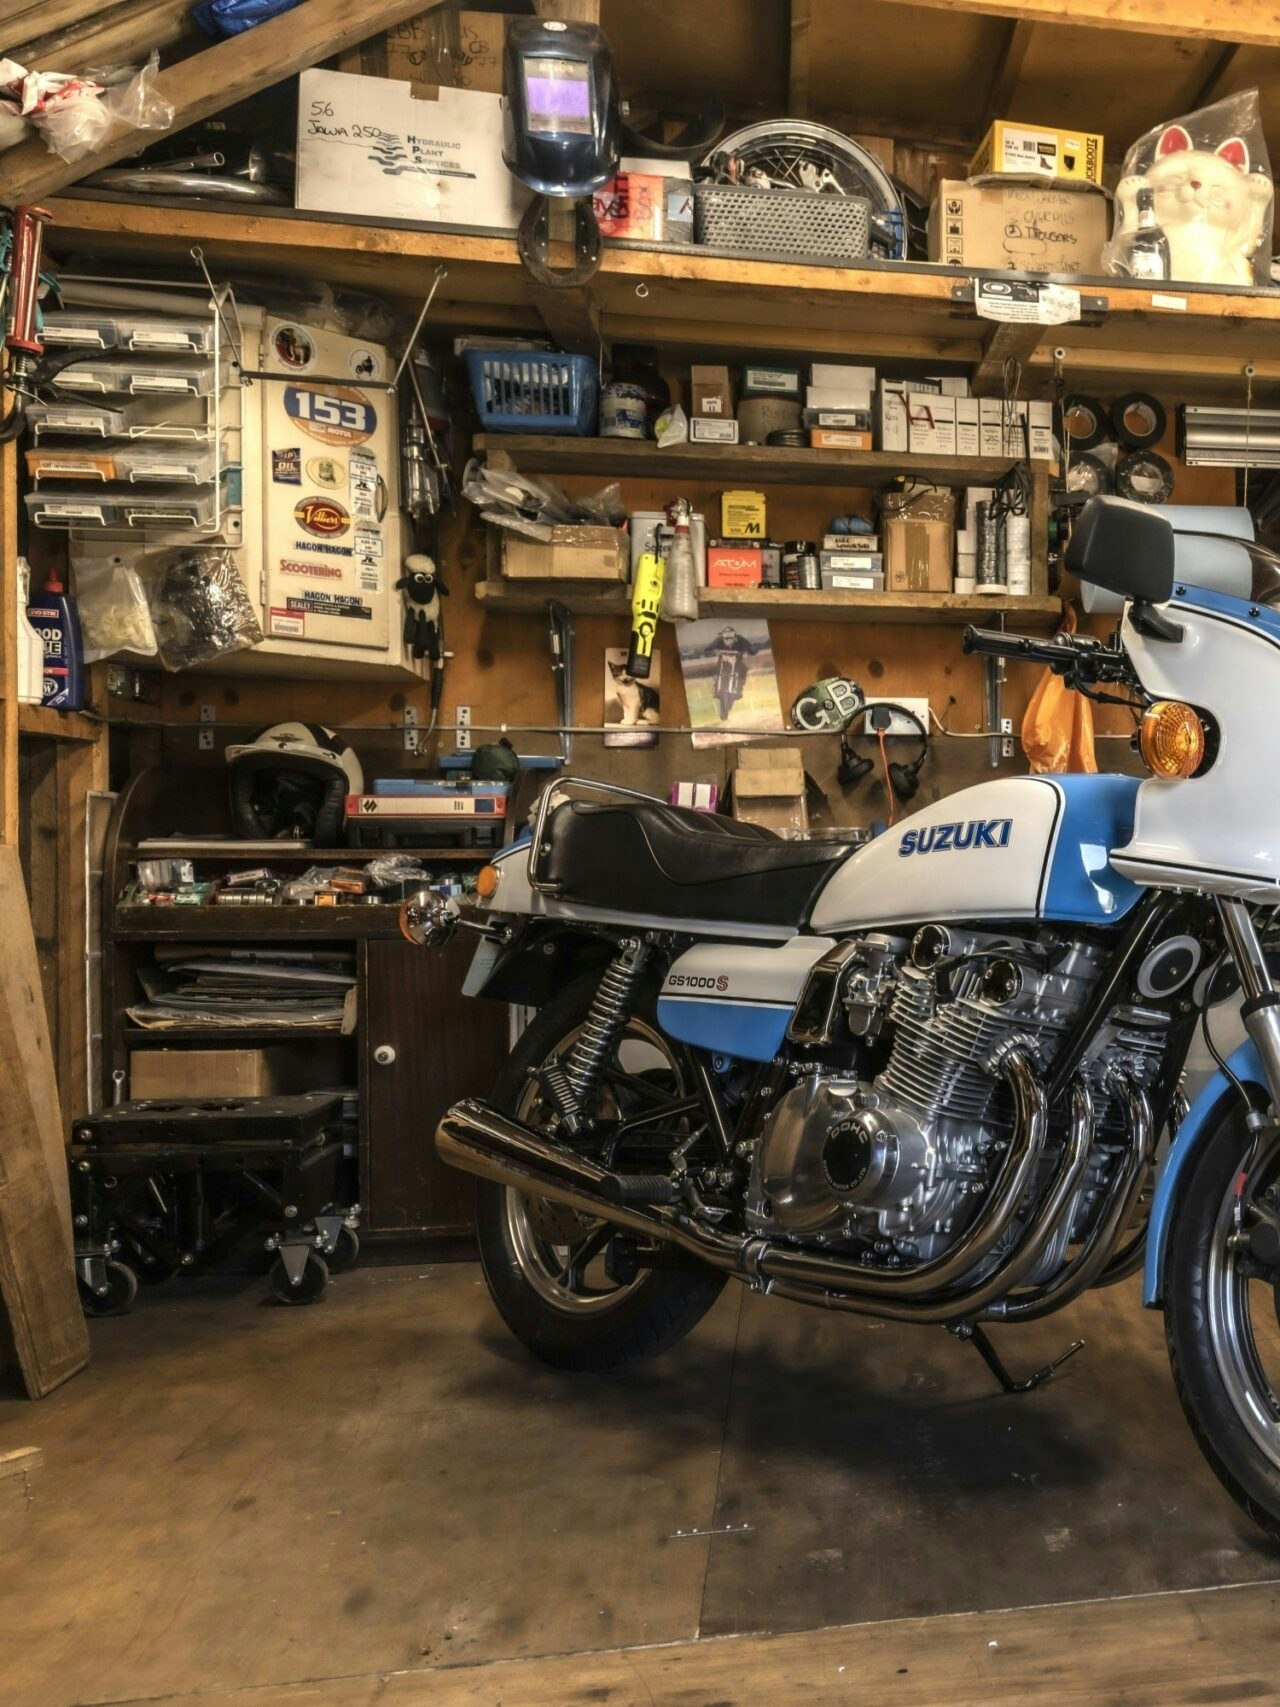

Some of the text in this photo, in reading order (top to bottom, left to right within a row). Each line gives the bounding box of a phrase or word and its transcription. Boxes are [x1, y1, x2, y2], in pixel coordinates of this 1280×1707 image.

[407, 135, 461, 149] HYDRAULIC
[412, 145, 443, 157] PLANT
[296, 392, 366, 431] 153
[296, 541, 323, 553] HAGON
[713, 558, 757, 569] ATOM
[304, 591, 361, 606] HAGON HAGON
[796, 680, 861, 732] GB
[899, 819, 1014, 857] SUZUKI
[668, 974, 729, 992] GS1000S
